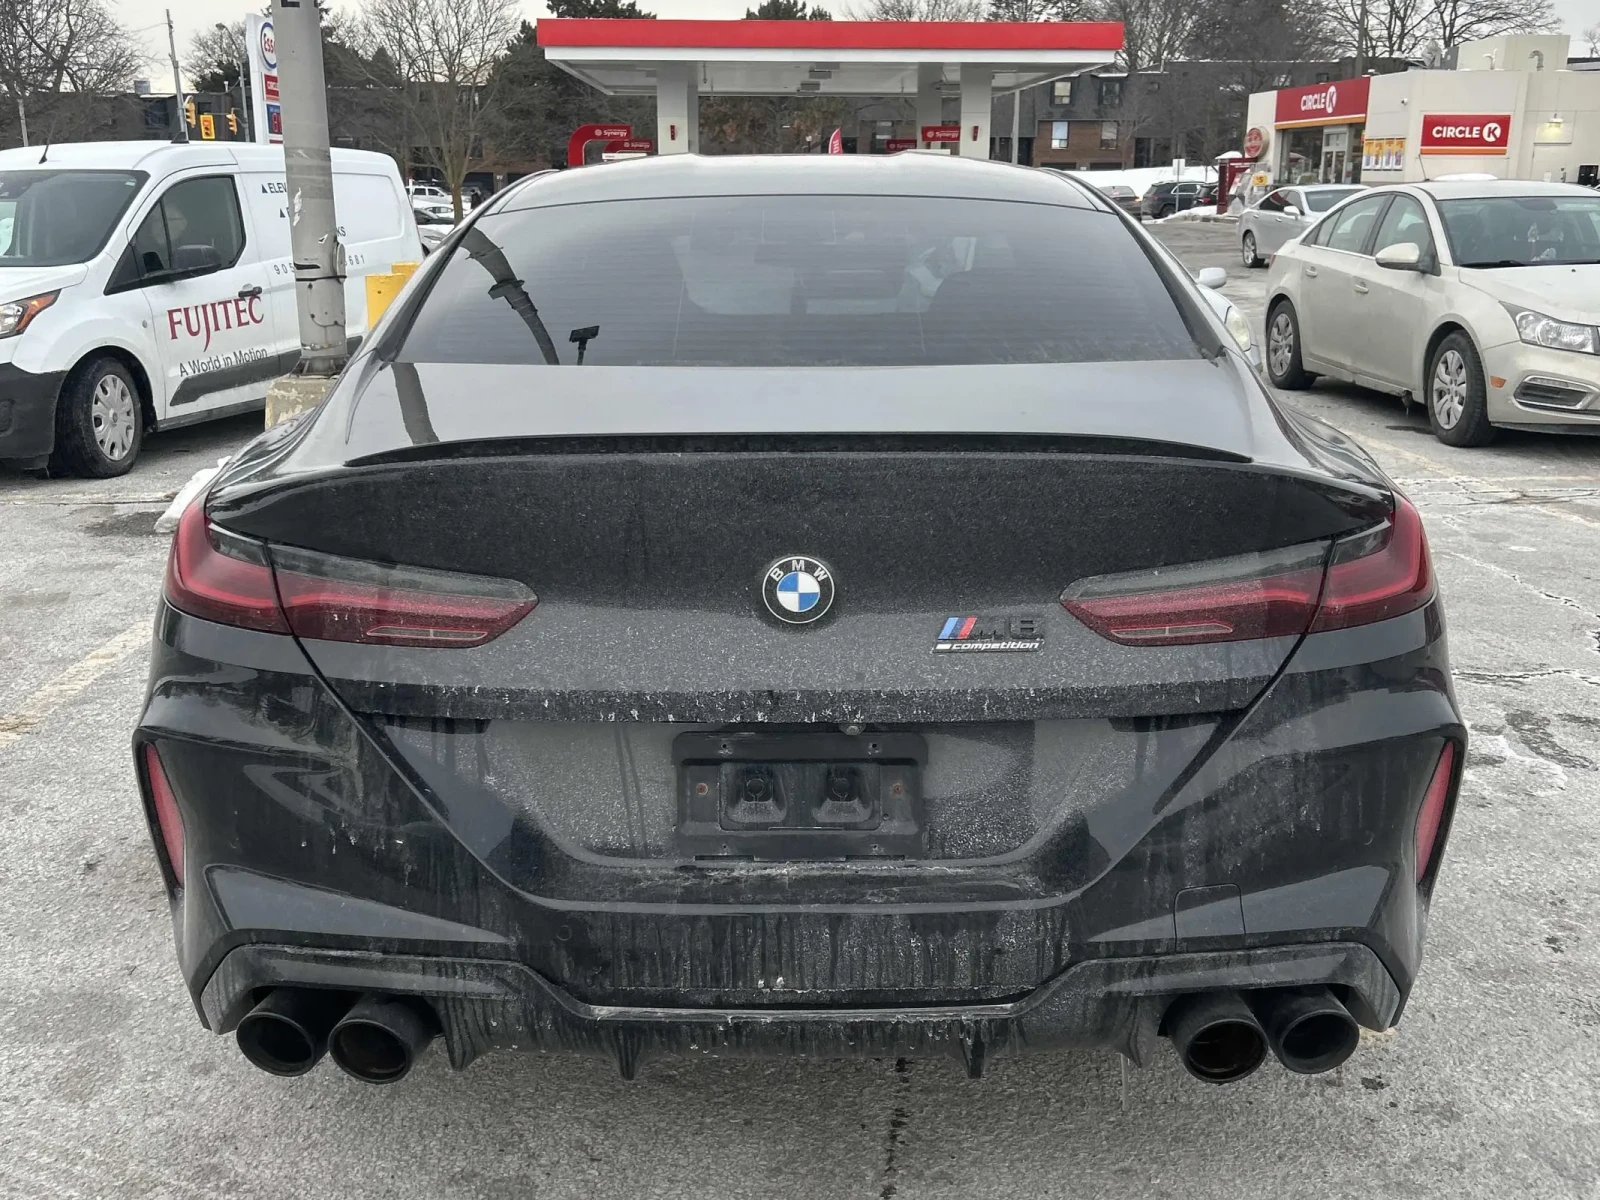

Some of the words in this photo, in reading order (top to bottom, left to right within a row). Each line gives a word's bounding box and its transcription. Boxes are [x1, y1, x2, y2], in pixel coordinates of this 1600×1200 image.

[264, 33, 276, 54] Ess
[1300, 93, 1326, 111] CIRCLE
[1327, 88, 1337, 113] K
[603, 129, 627, 137] Synergy
[1431, 126, 1481, 138] CIRCLE
[1485, 125, 1501, 141] K
[167, 295, 264, 352] FUJITEC
[179, 362, 188, 377] A
[188, 355, 221, 375] World
[221, 353, 233, 367] in
[233, 347, 268, 366] Motion
[769, 559, 829, 582] BMW
[951, 641, 1040, 651] competition
